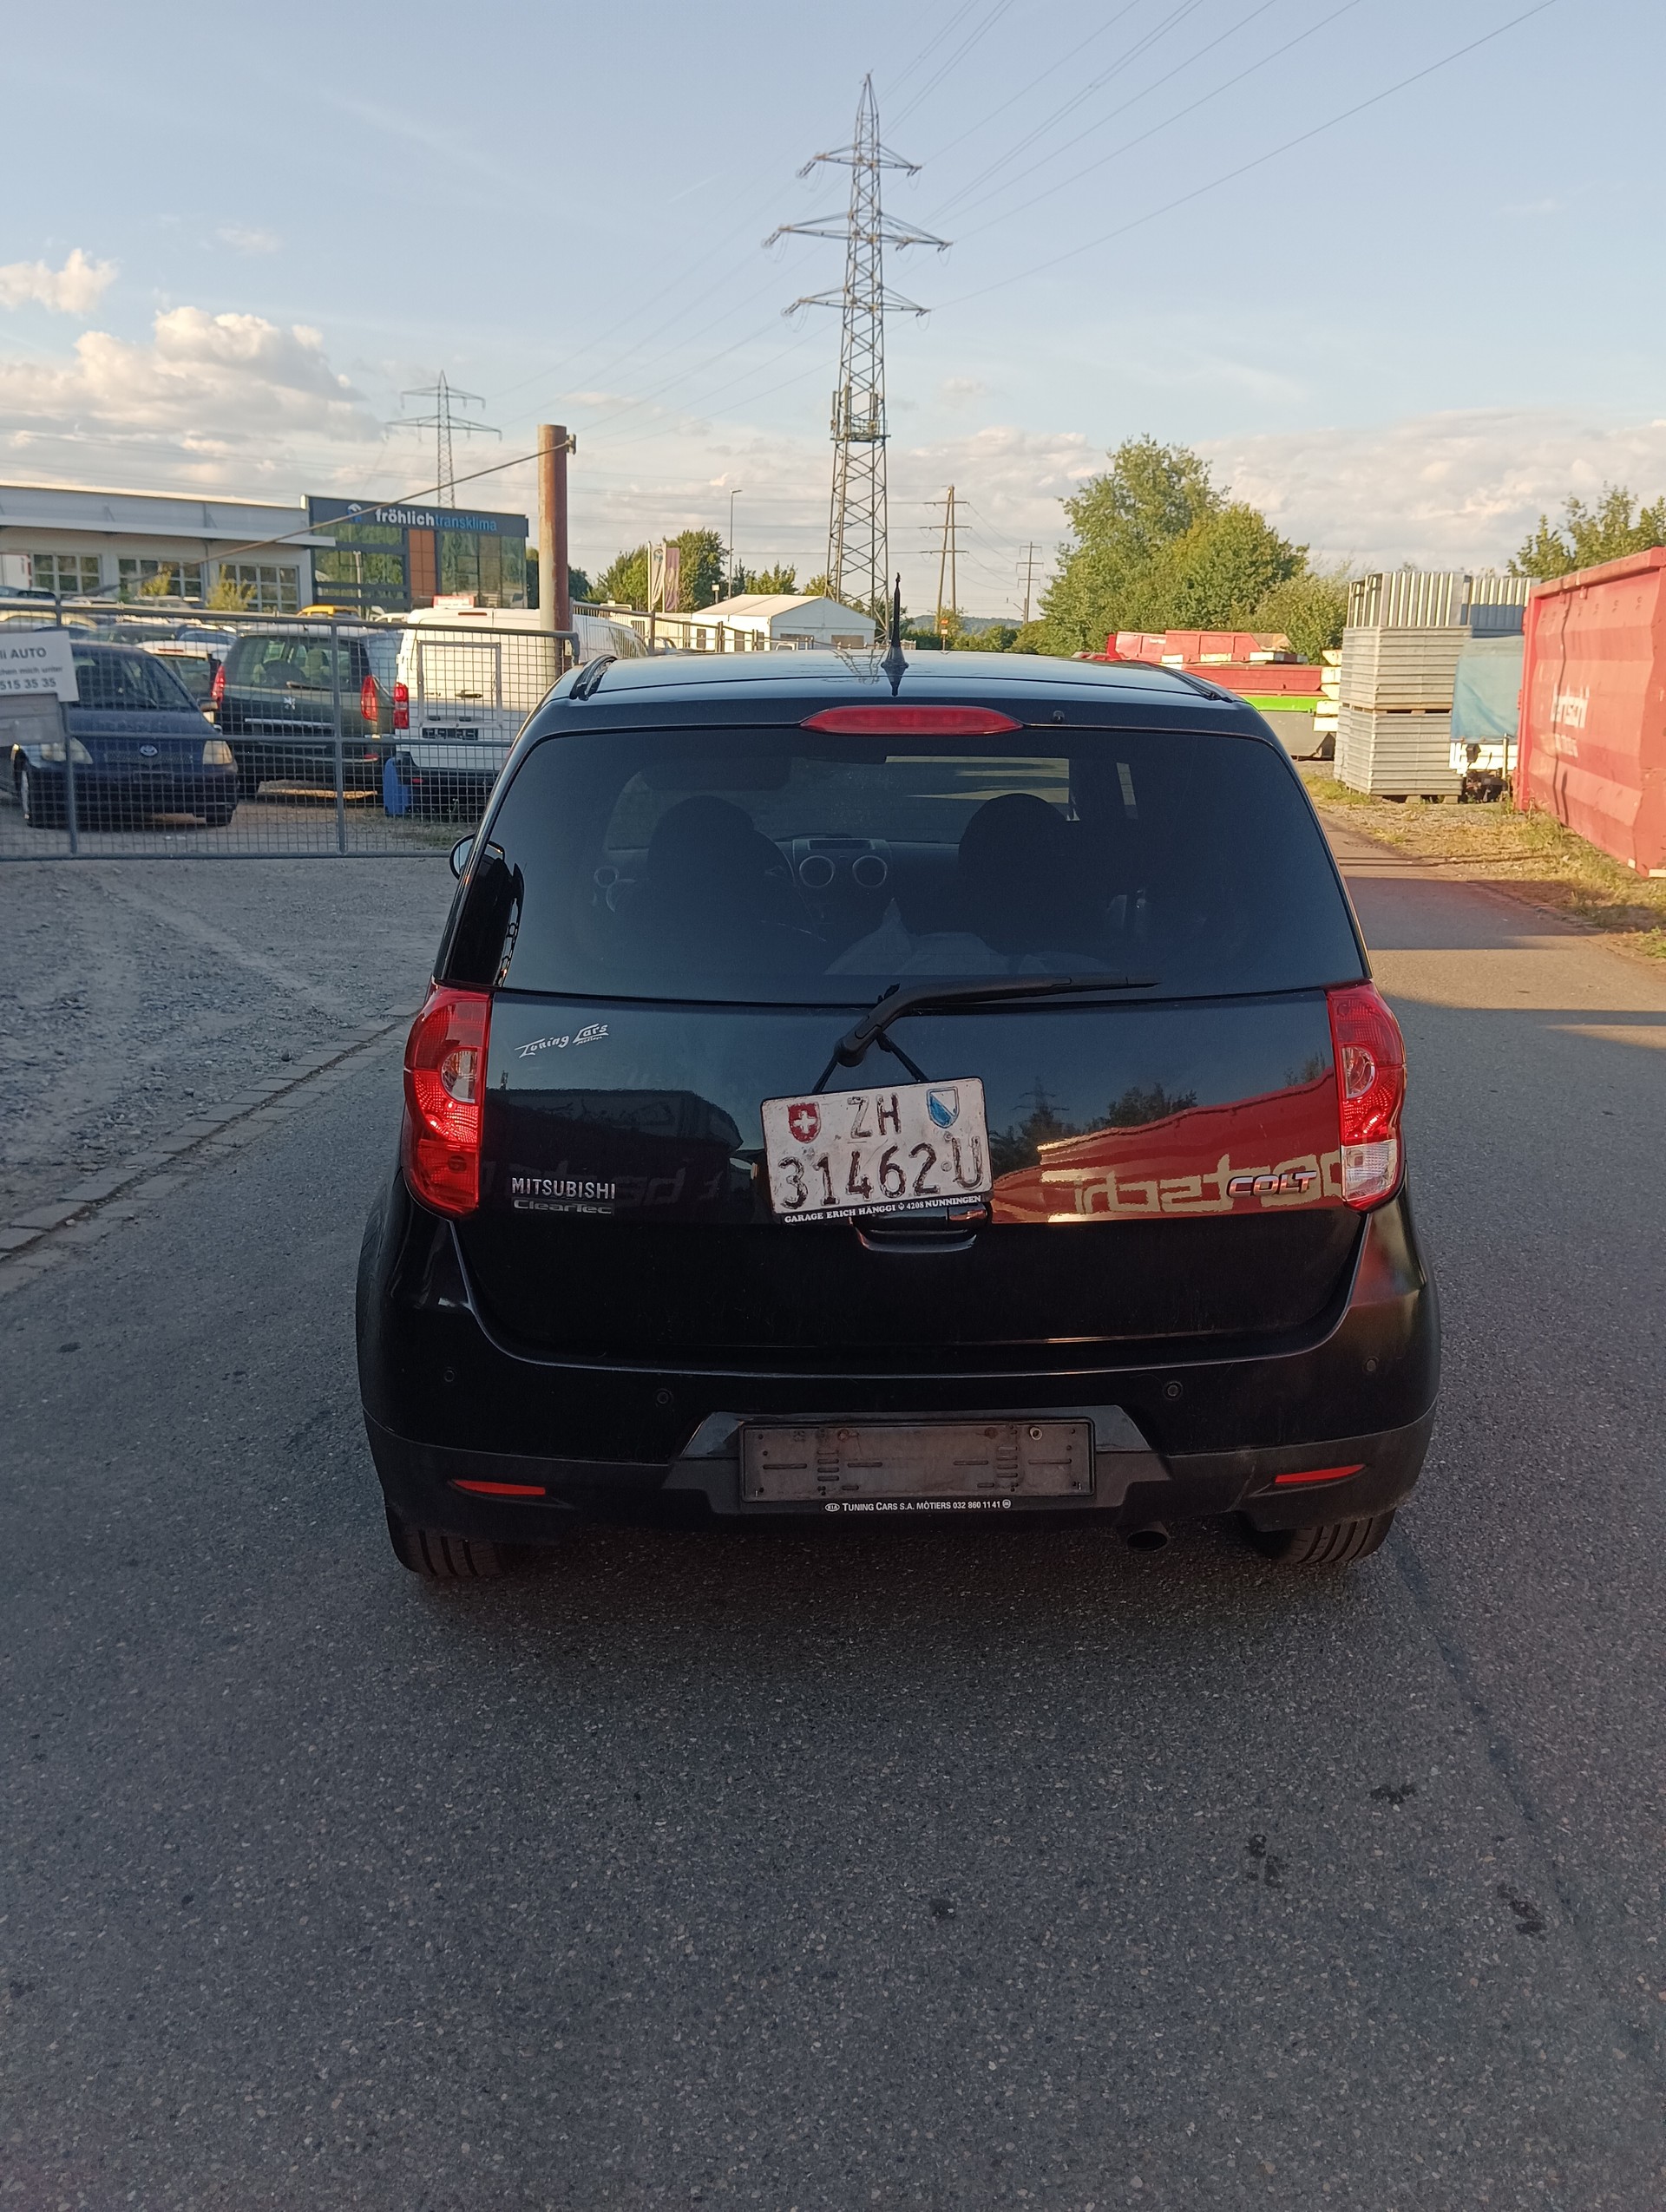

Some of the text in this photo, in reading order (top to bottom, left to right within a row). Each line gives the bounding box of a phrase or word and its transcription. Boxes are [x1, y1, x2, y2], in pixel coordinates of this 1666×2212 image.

[10, 646, 47, 659] AUTO
[23, 678, 39, 689] 35
[42, 677, 57, 688] 35
[515, 1023, 609, 1058] Tuning Cars
[847, 1092, 902, 1139] ZH
[511, 1176, 616, 1199] MITSUBISHI
[1226, 1170, 1317, 1197] COLT
[513, 1199, 613, 1214] ClearTec
[784, 1194, 982, 1224] GARAGE ERICH HÄNGGI 4208 NUNNINGEN
[842, 1502, 874, 1511] TUNING
[876, 1502, 898, 1511] CARS
